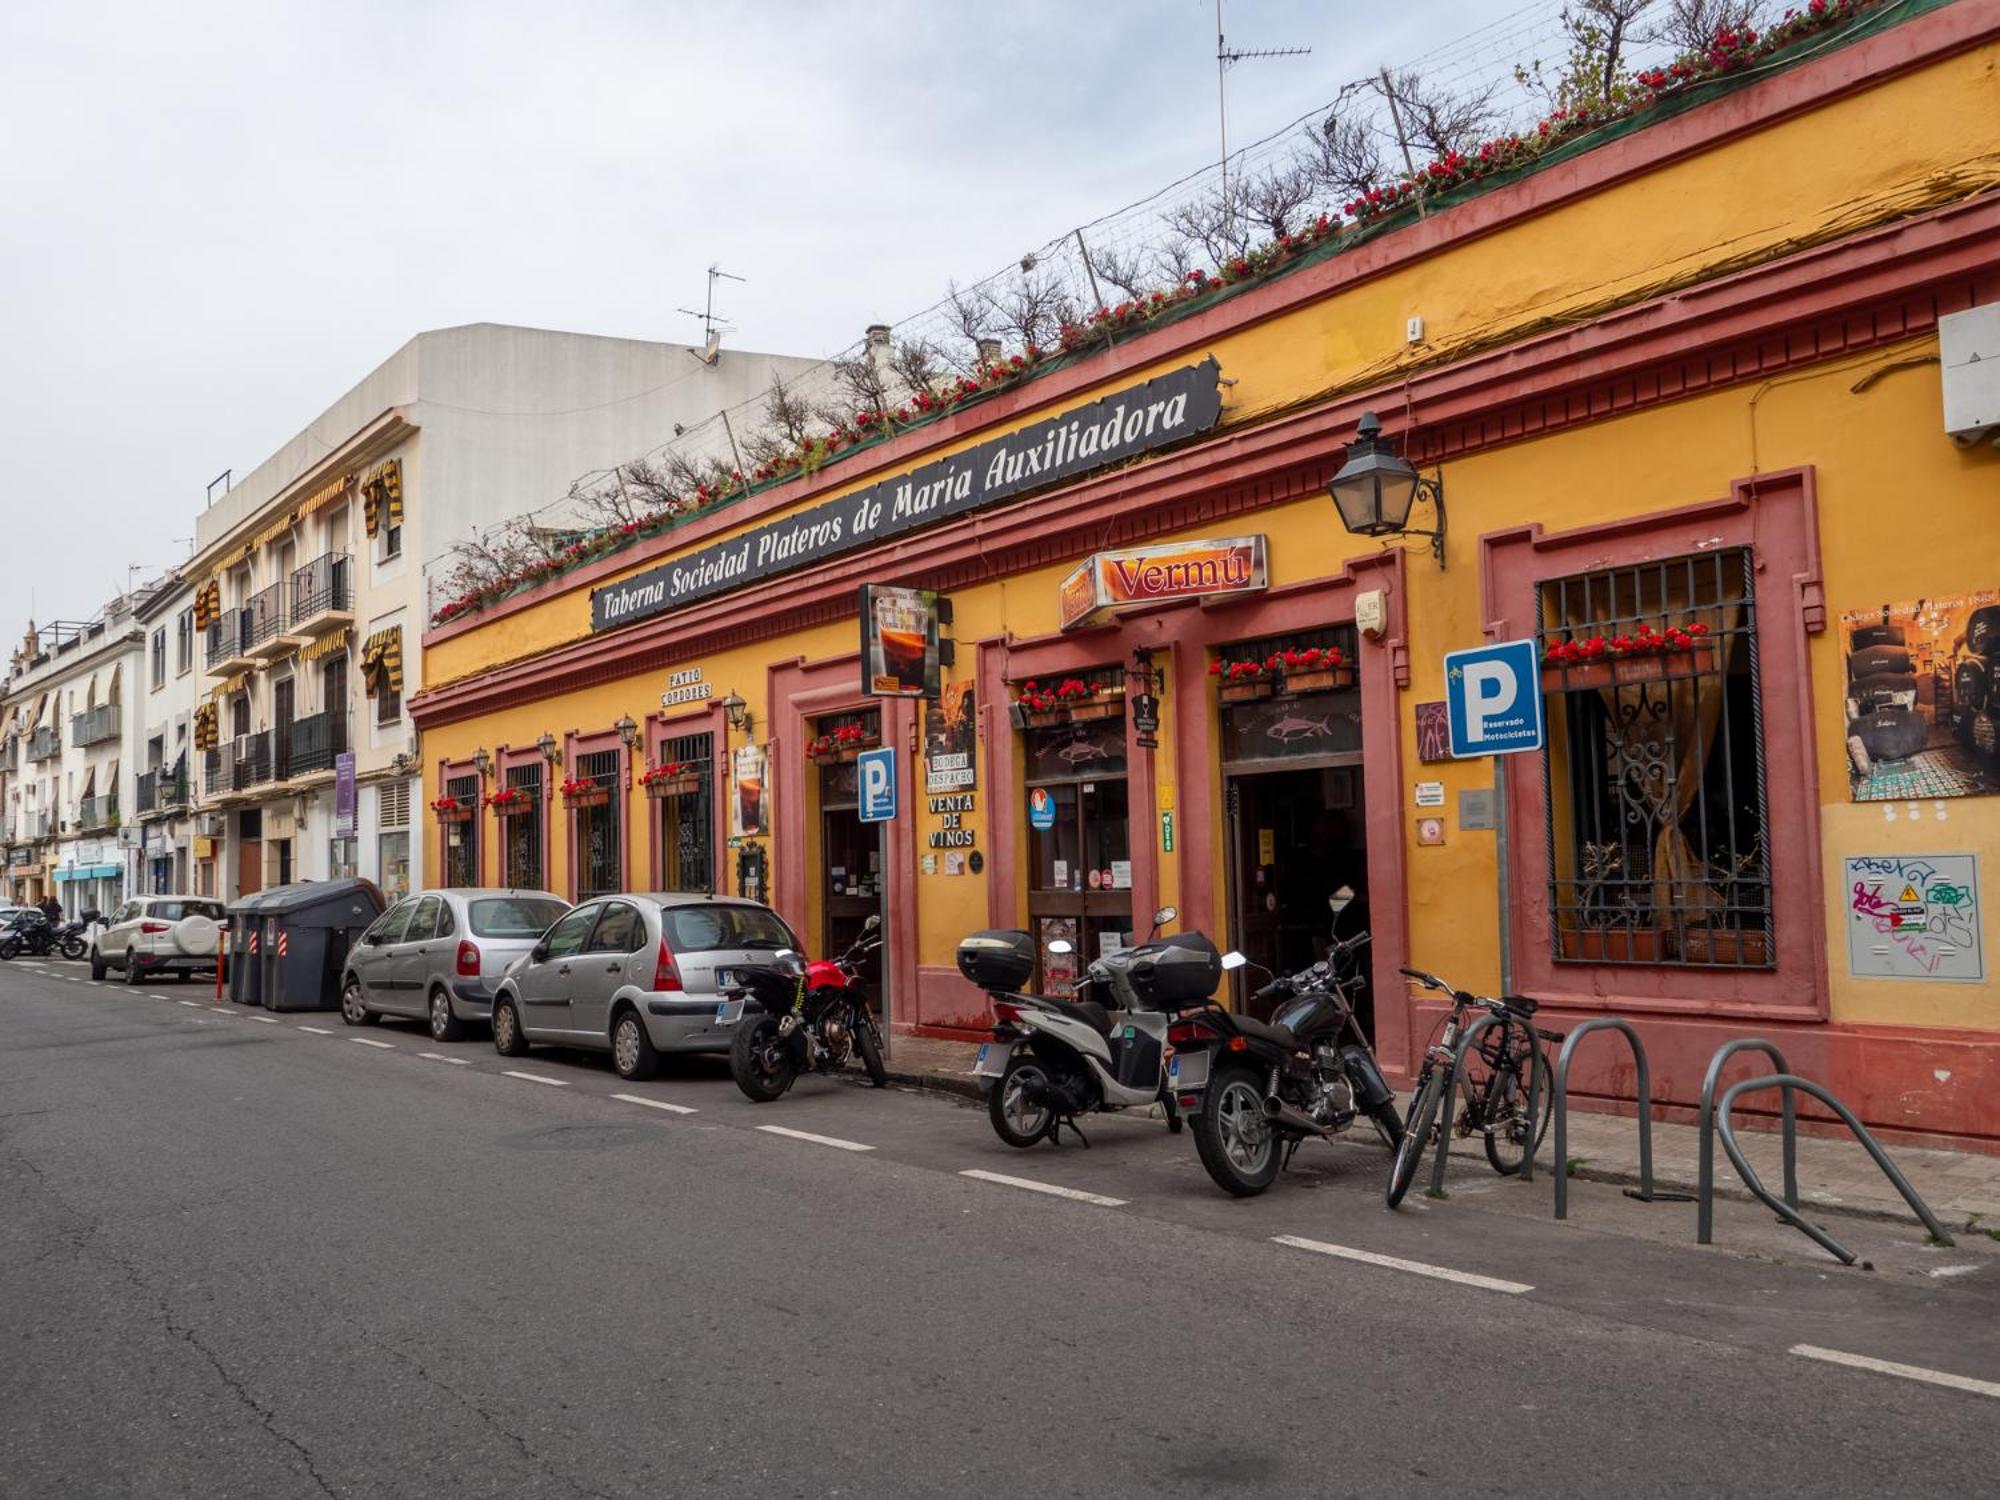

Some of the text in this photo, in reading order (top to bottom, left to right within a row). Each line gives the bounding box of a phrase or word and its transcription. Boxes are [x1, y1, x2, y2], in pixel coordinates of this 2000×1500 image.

[604, 391, 1188, 619] Taberna Sociedad Plateros de María Auxiliadora
[1112, 545, 1249, 596] Vermú
[670, 668, 700, 686] PATIO
[1463, 660, 1518, 743] P
[1483, 717, 1525, 729] Reservado
[1484, 729, 1537, 741] Motocicletas
[933, 754, 967, 770] BODEGA
[865, 759, 887, 812] P
[929, 770, 973, 786] DESPACHO
[929, 796, 974, 813] VENTA
[943, 813, 961, 829] DE
[929, 831, 973, 848] VINOS
